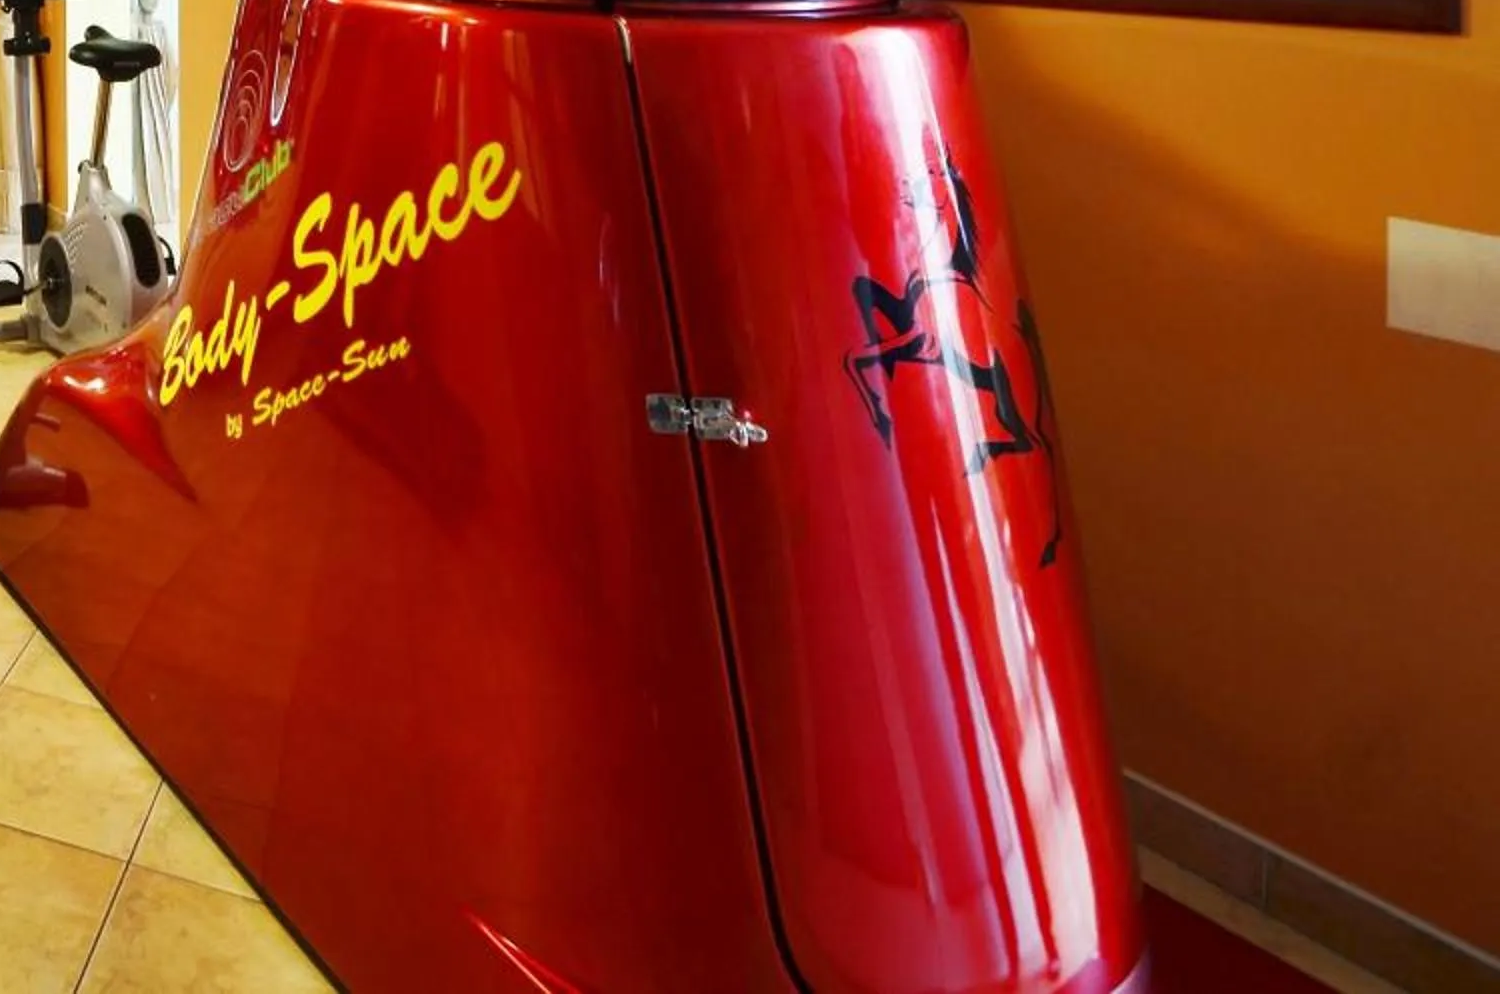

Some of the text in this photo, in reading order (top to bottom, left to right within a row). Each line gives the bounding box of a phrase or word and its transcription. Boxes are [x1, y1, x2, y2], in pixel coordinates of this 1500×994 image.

[160, 141, 520, 404] Body-Space
[226, 336, 411, 438] by Space-Sun
